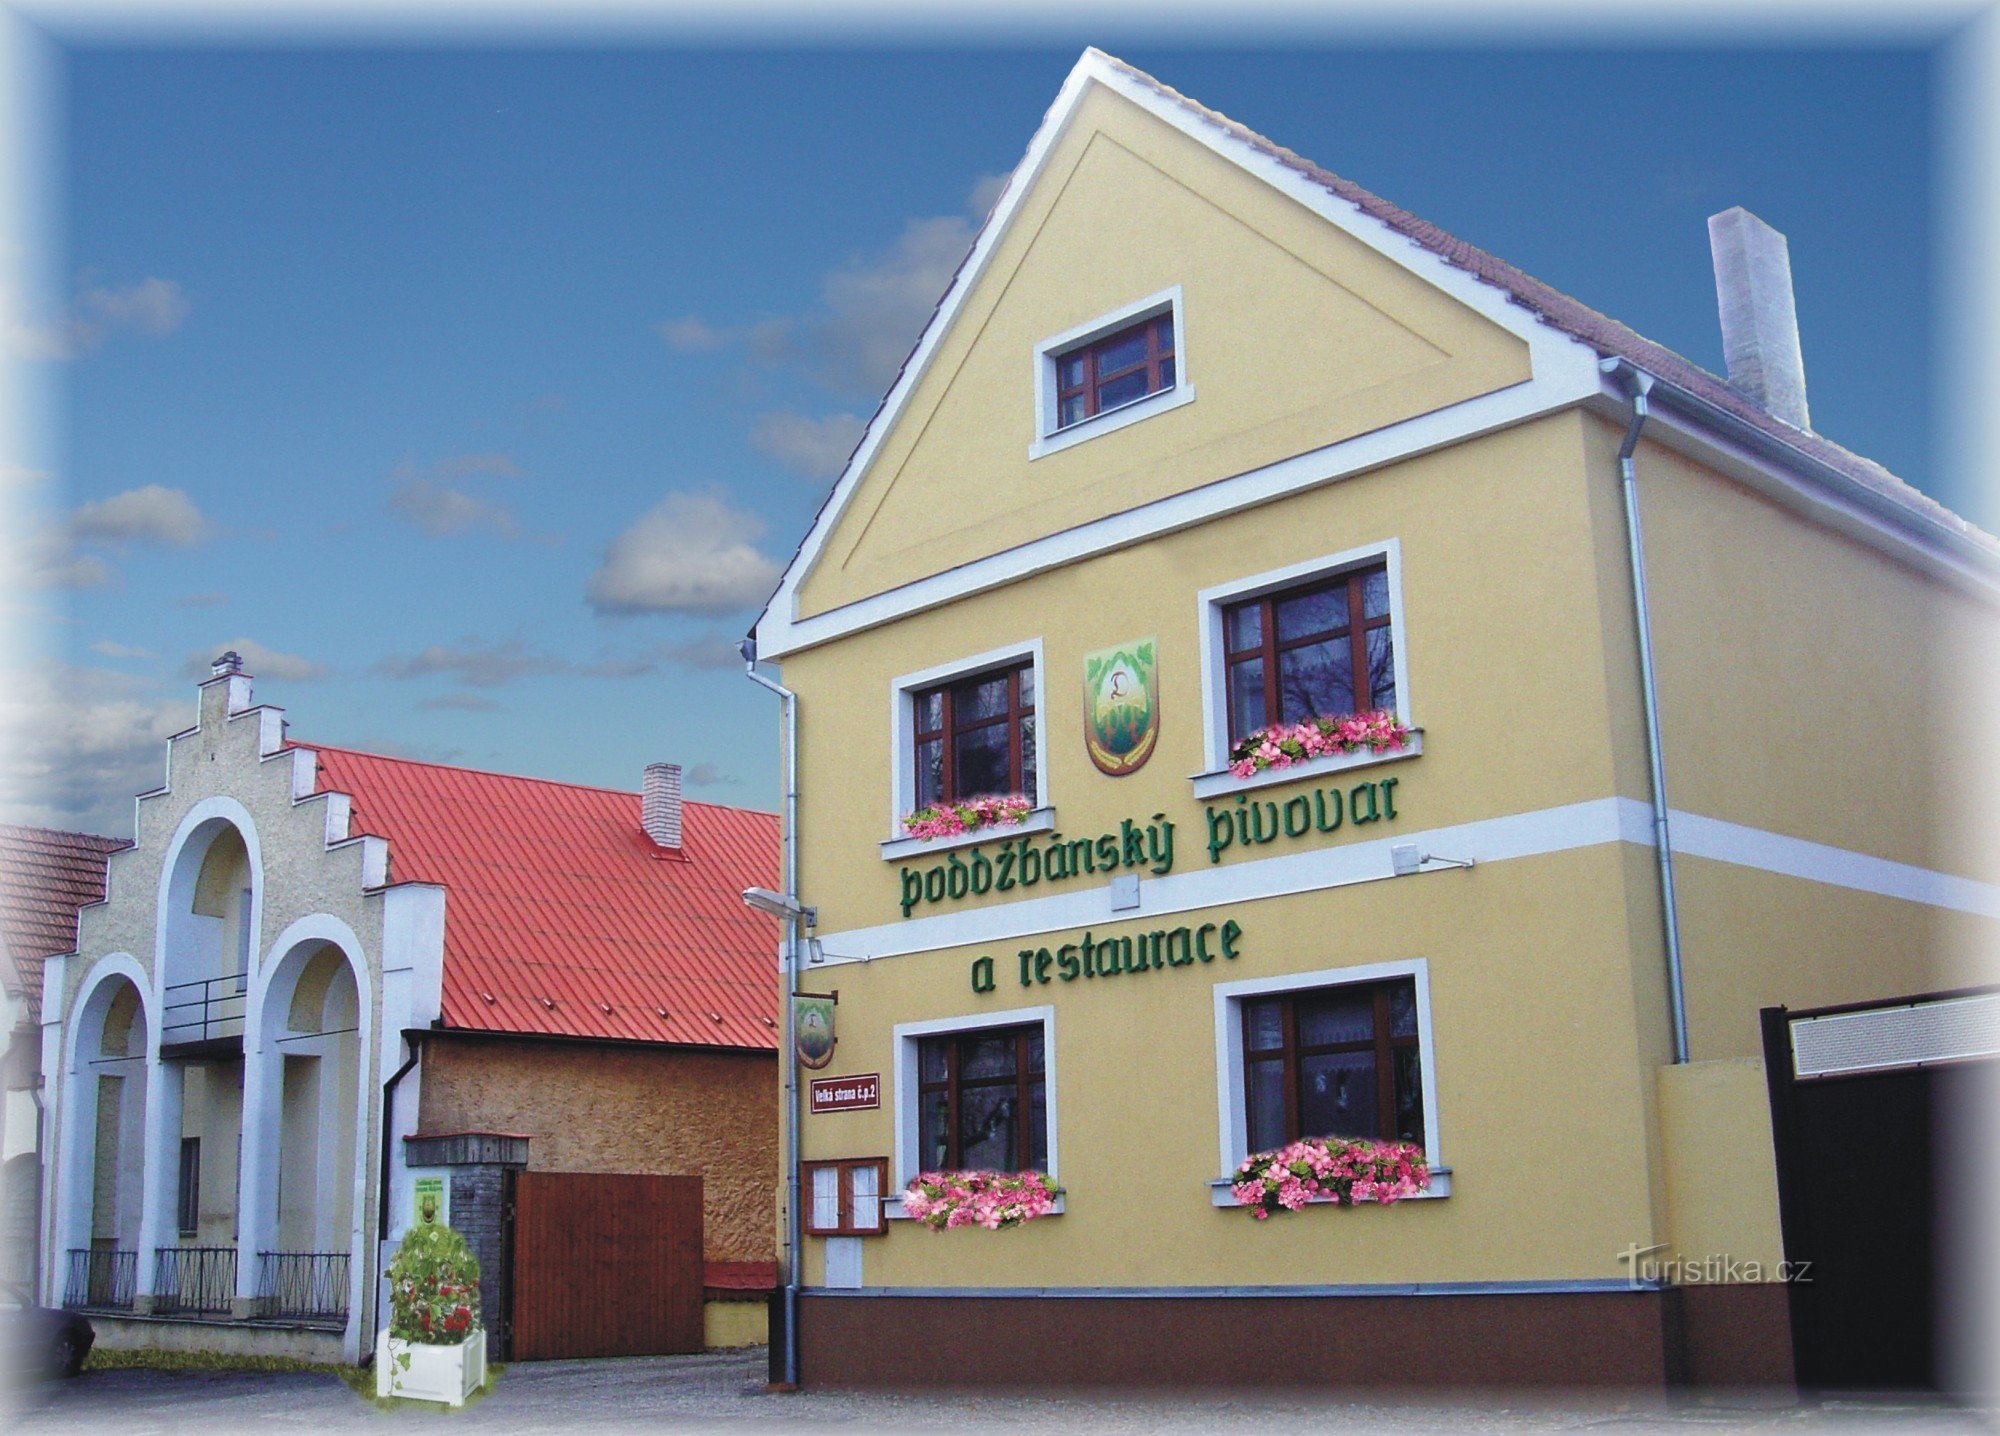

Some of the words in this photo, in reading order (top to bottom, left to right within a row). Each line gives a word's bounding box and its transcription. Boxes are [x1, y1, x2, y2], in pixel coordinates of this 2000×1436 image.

[900, 812, 1175, 917] poddžbánský
[1206, 777, 1399, 863] pivovar
[971, 953, 996, 993] a
[1018, 918, 1243, 987] restaurace
[815, 1088, 833, 1102] Velká
[835, 1087, 856, 1101] strana
